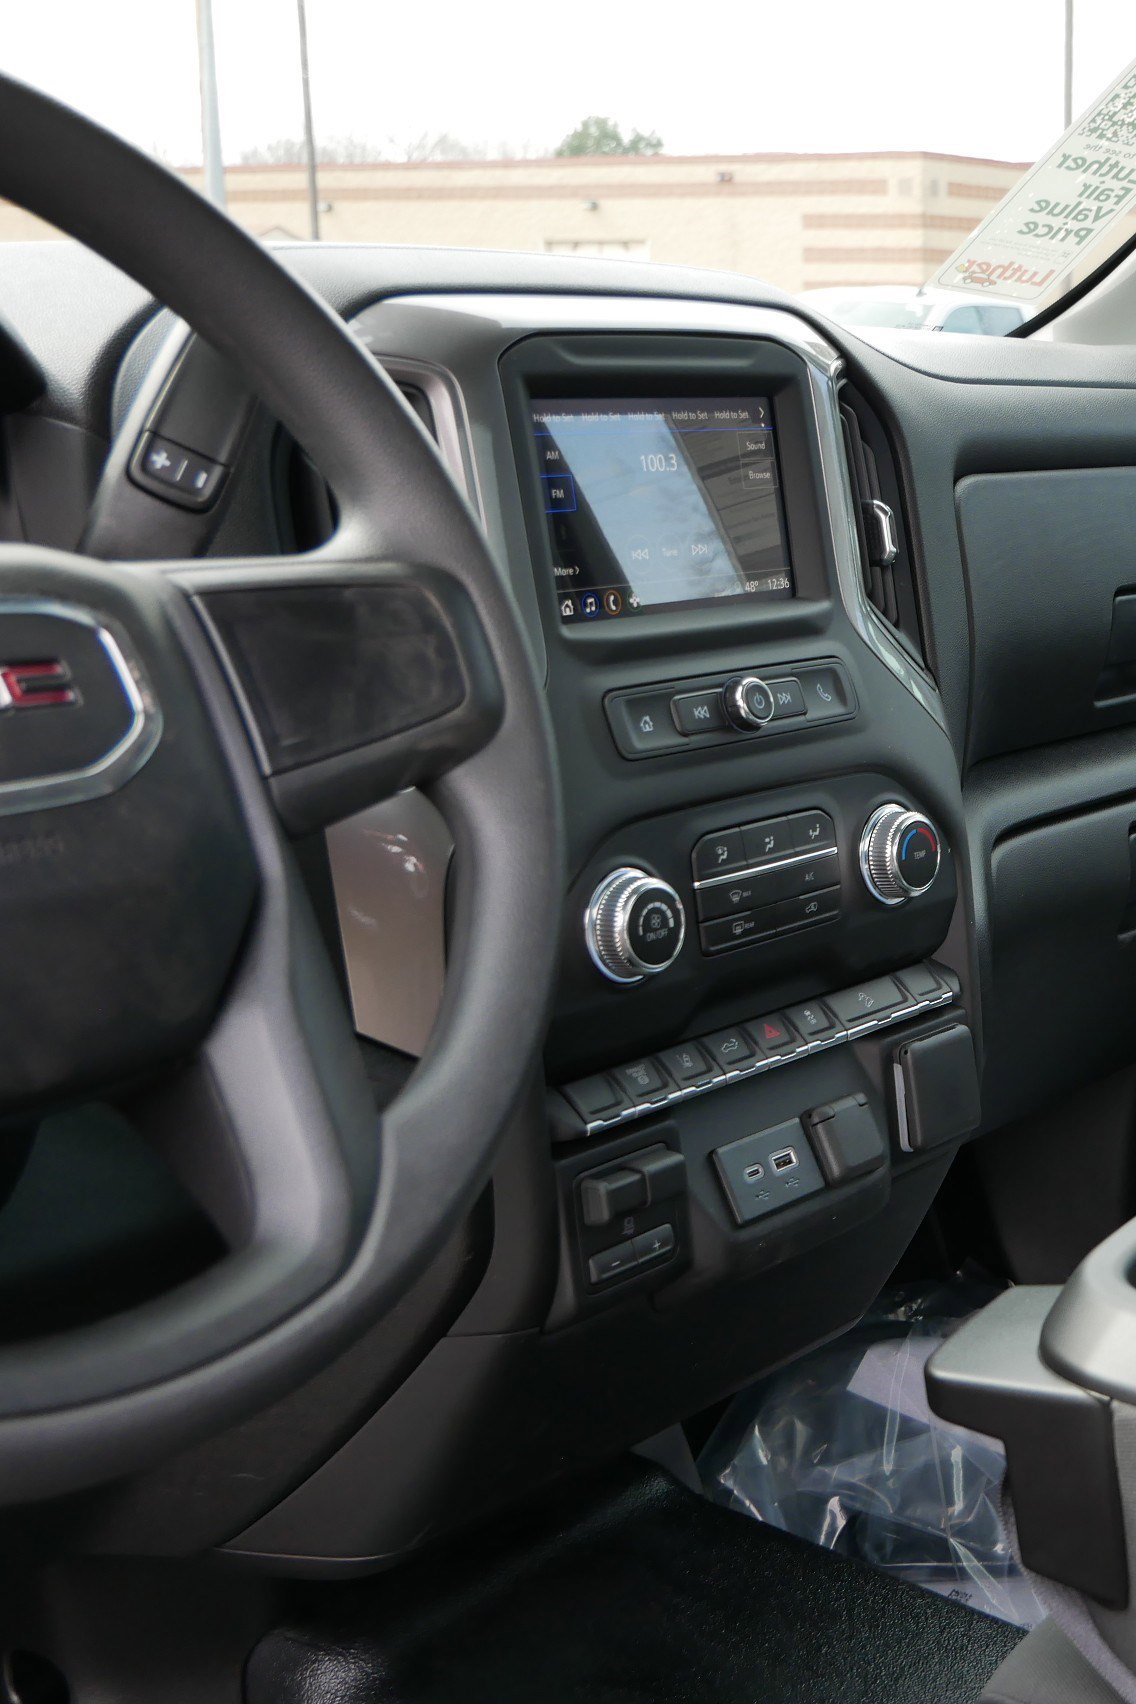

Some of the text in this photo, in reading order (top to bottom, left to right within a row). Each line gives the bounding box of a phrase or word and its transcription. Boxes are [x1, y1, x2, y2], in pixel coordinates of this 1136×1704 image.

[672, 410, 708, 420] Hold to Set
[714, 410, 749, 419] Hold to Set
[746, 441, 766, 451] Sound
[546, 451, 560, 460] AM
[640, 453, 678, 472] 100.3
[749, 470, 771, 480] Browse
[552, 489, 565, 499] FM
[554, 566, 574, 576] More
[768, 578, 790, 591] 12:36
[914, 850, 926, 860] TEMP
[646, 927, 668, 942] ON/OFF
